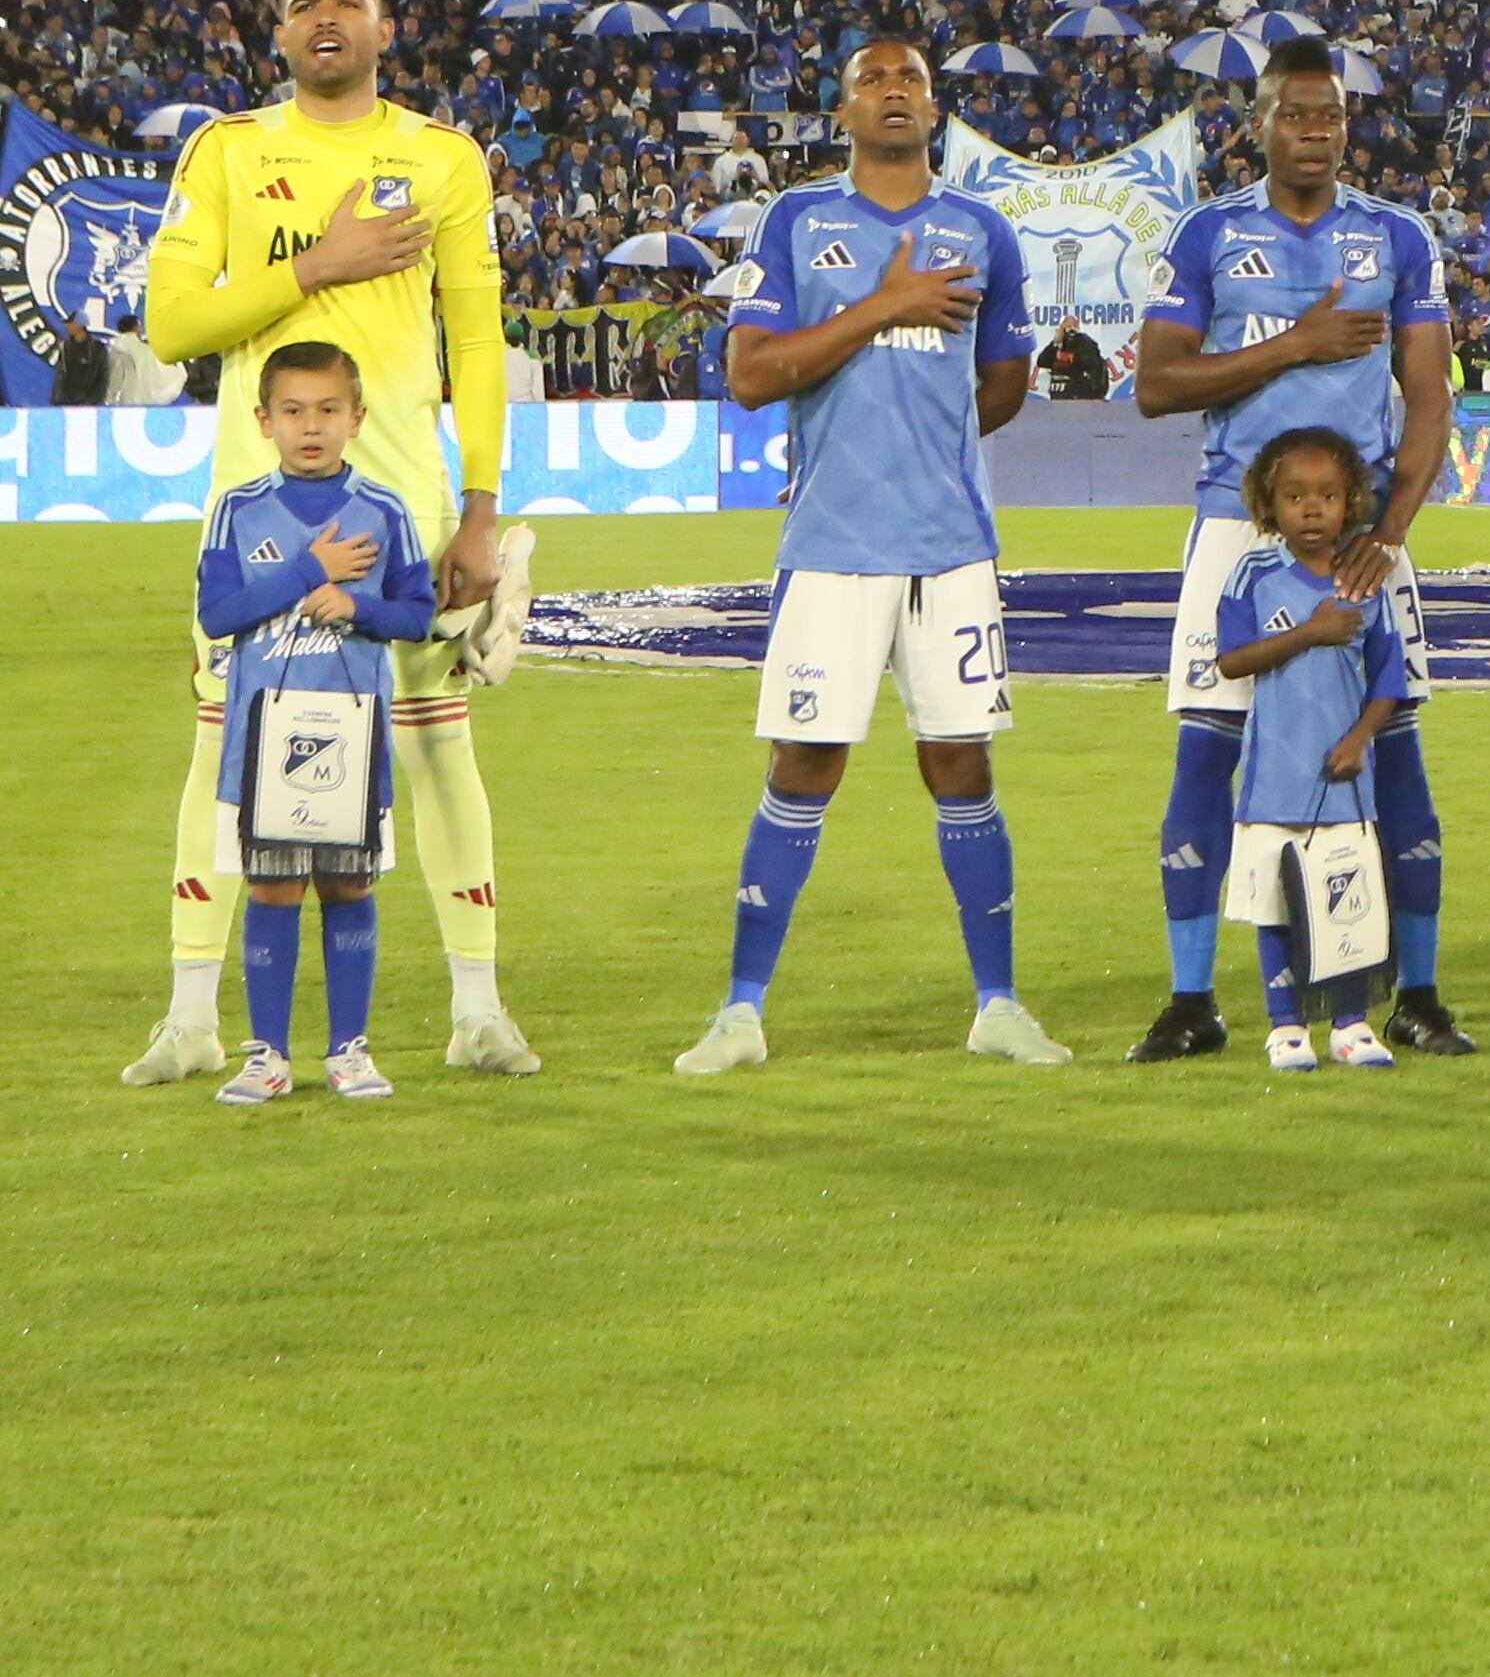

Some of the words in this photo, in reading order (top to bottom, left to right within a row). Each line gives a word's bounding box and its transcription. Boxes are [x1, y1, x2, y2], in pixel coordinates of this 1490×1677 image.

[1045, 166, 1099, 181] 2010
[996, 182, 1051, 222] MÁS
[1060, 182, 1134, 216] ALLÁ
[1126, 203, 1162, 243] DE
[268, 226, 322, 266] AN
[1034, 302, 1134, 326] UBICANA
[1241, 313, 1296, 348] AN
[954, 623, 1006, 685] 20
